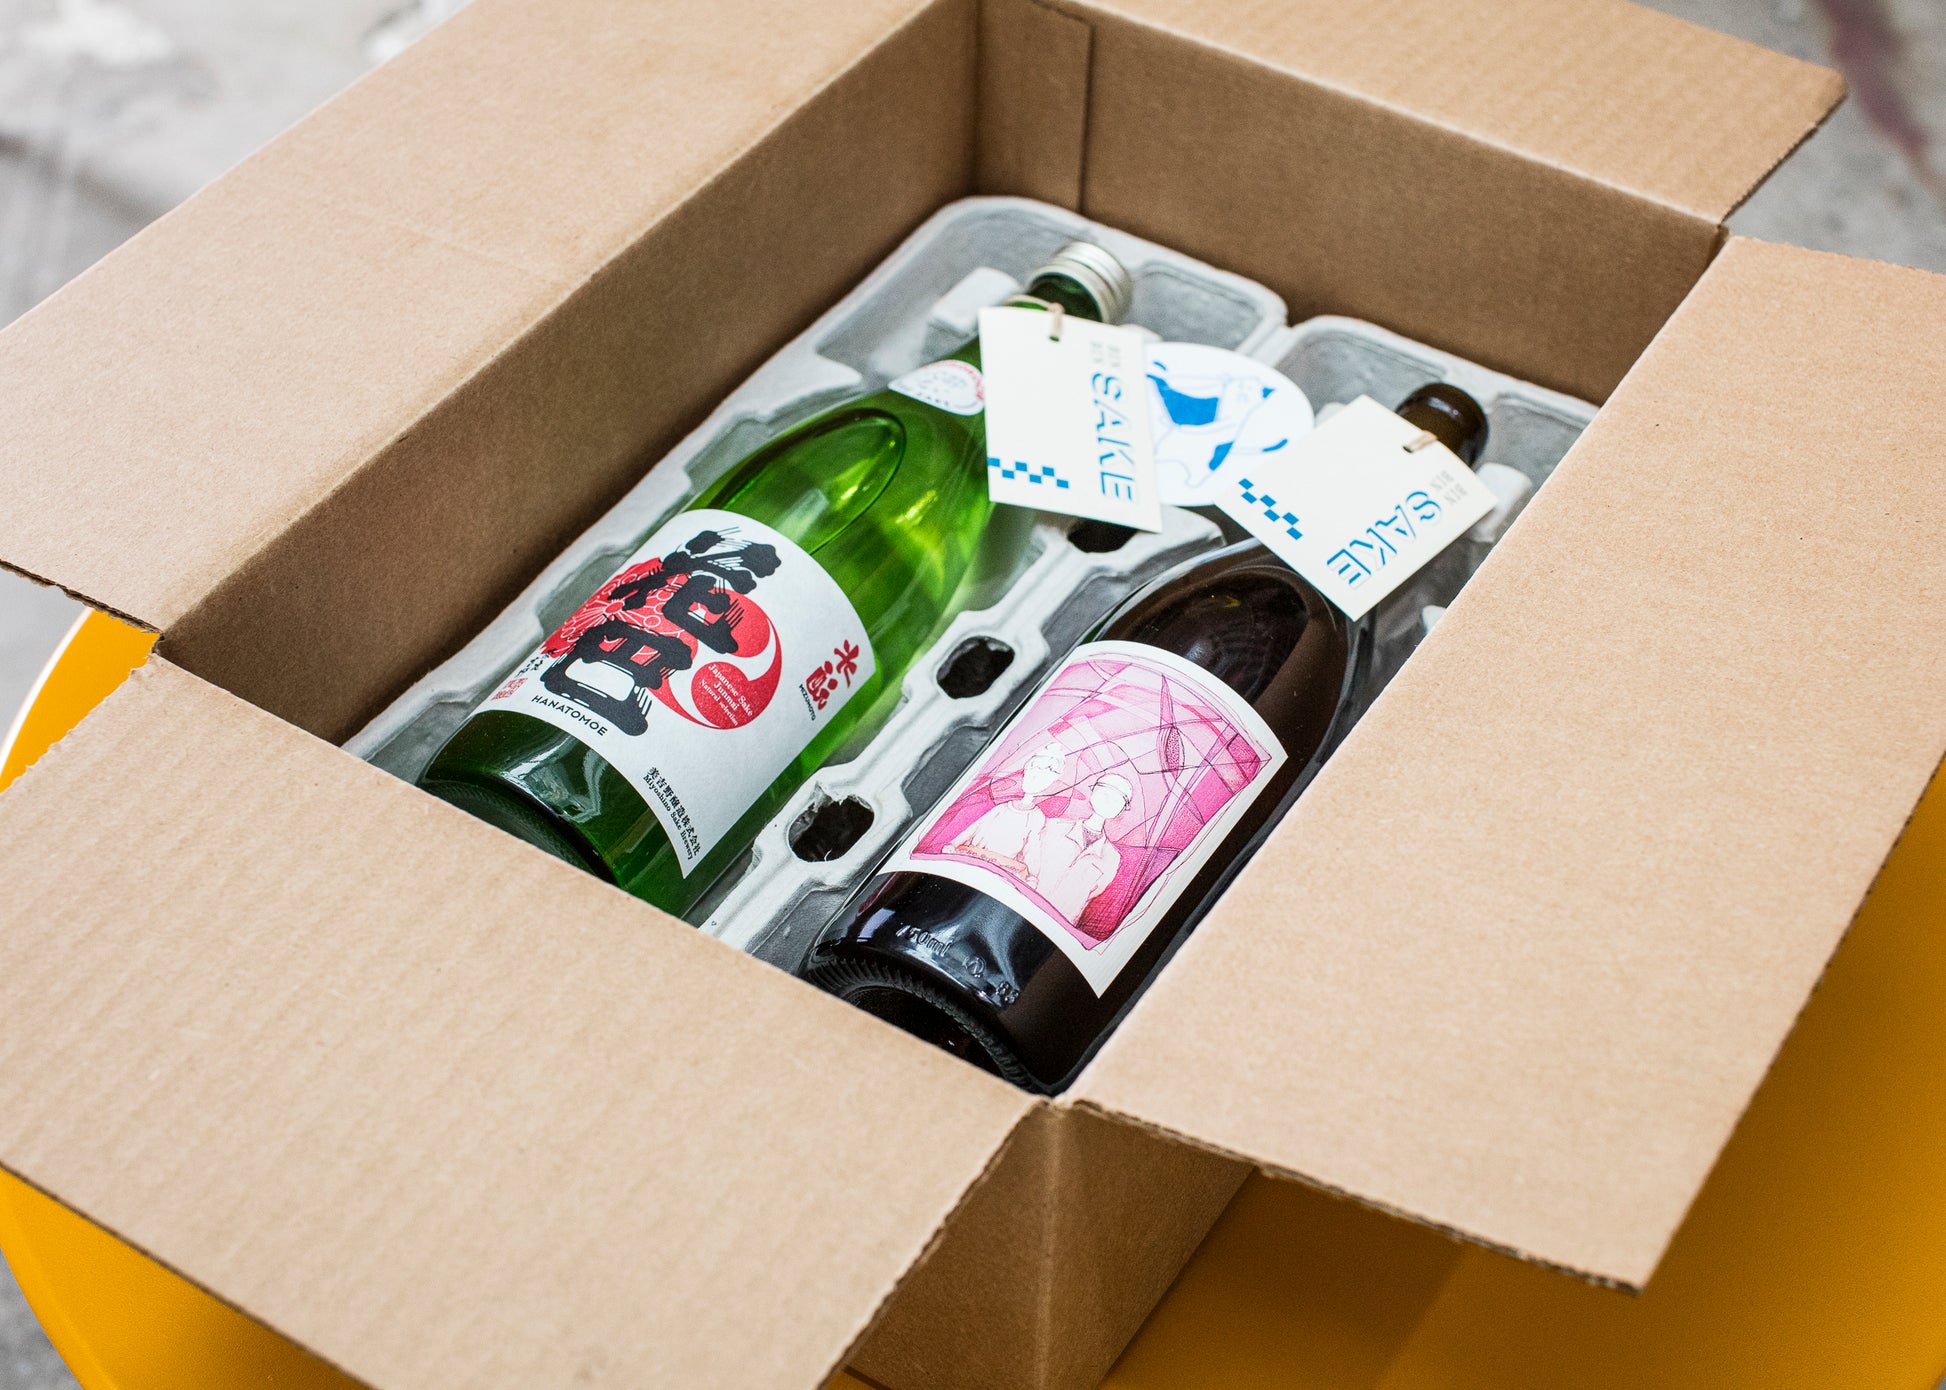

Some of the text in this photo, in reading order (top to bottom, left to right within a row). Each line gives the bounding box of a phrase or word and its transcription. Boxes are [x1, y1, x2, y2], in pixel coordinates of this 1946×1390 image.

[1091, 372, 1139, 501] SAKE
[1326, 490, 1444, 590] SAKE
[699, 679, 739, 726] Natural selection
[708, 664, 753, 717] Japanese Sake
[713, 681, 740, 711] Junmai
[798, 683, 817, 721] MIZUMOTO
[531, 695, 608, 737] HANATOMOE
[642, 774, 694, 861] Miyoshino Sake Brewery
